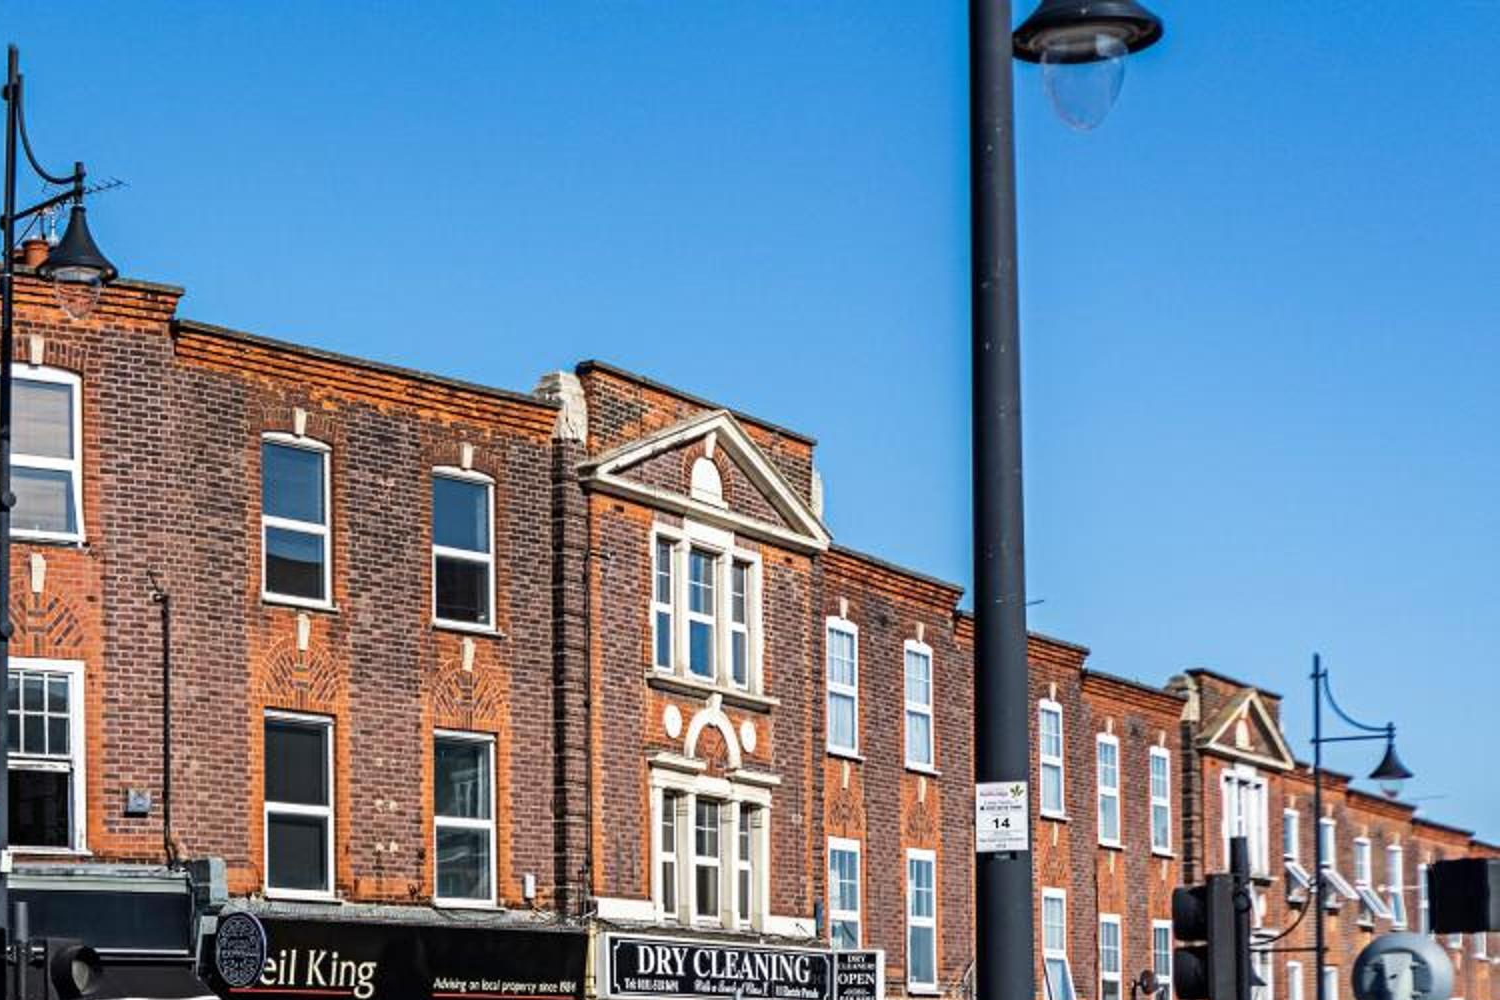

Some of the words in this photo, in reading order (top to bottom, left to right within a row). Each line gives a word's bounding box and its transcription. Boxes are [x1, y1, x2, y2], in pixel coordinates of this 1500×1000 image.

[992, 817, 1010, 829] 14
[637, 945, 688, 976] DRY
[693, 949, 810, 983] CLEANING
[260, 949, 297, 985] eil
[306, 949, 377, 999] King
[837, 973, 875, 985] OPEN
[433, 977, 466, 992] Advising
[469, 980, 480, 990] on
[482, 977, 500, 991] local
[502, 980, 536, 994] property
[538, 981, 558, 992] since
